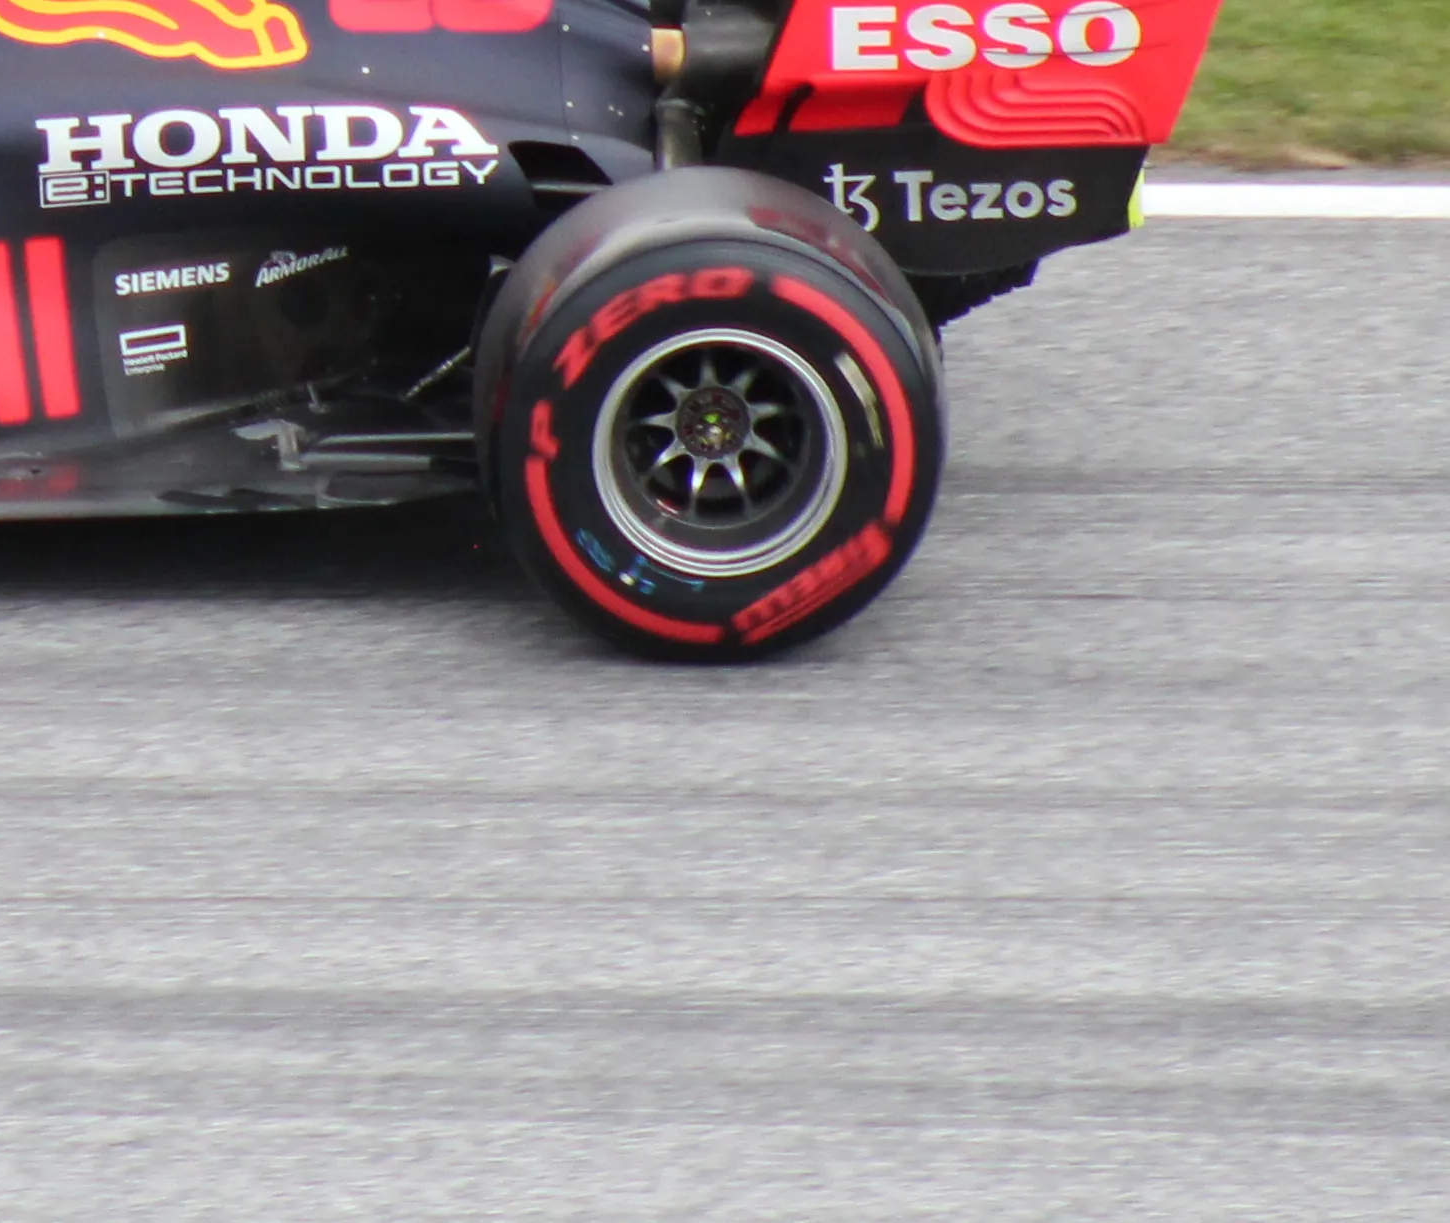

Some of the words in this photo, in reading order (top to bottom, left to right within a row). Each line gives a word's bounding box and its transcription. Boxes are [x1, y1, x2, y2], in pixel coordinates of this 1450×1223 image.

[830, 0, 1142, 72] ESSO
[35, 104, 499, 174] HONDA
[893, 170, 1077, 223] Tezos
[115, 262, 230, 296] SIEMENS
